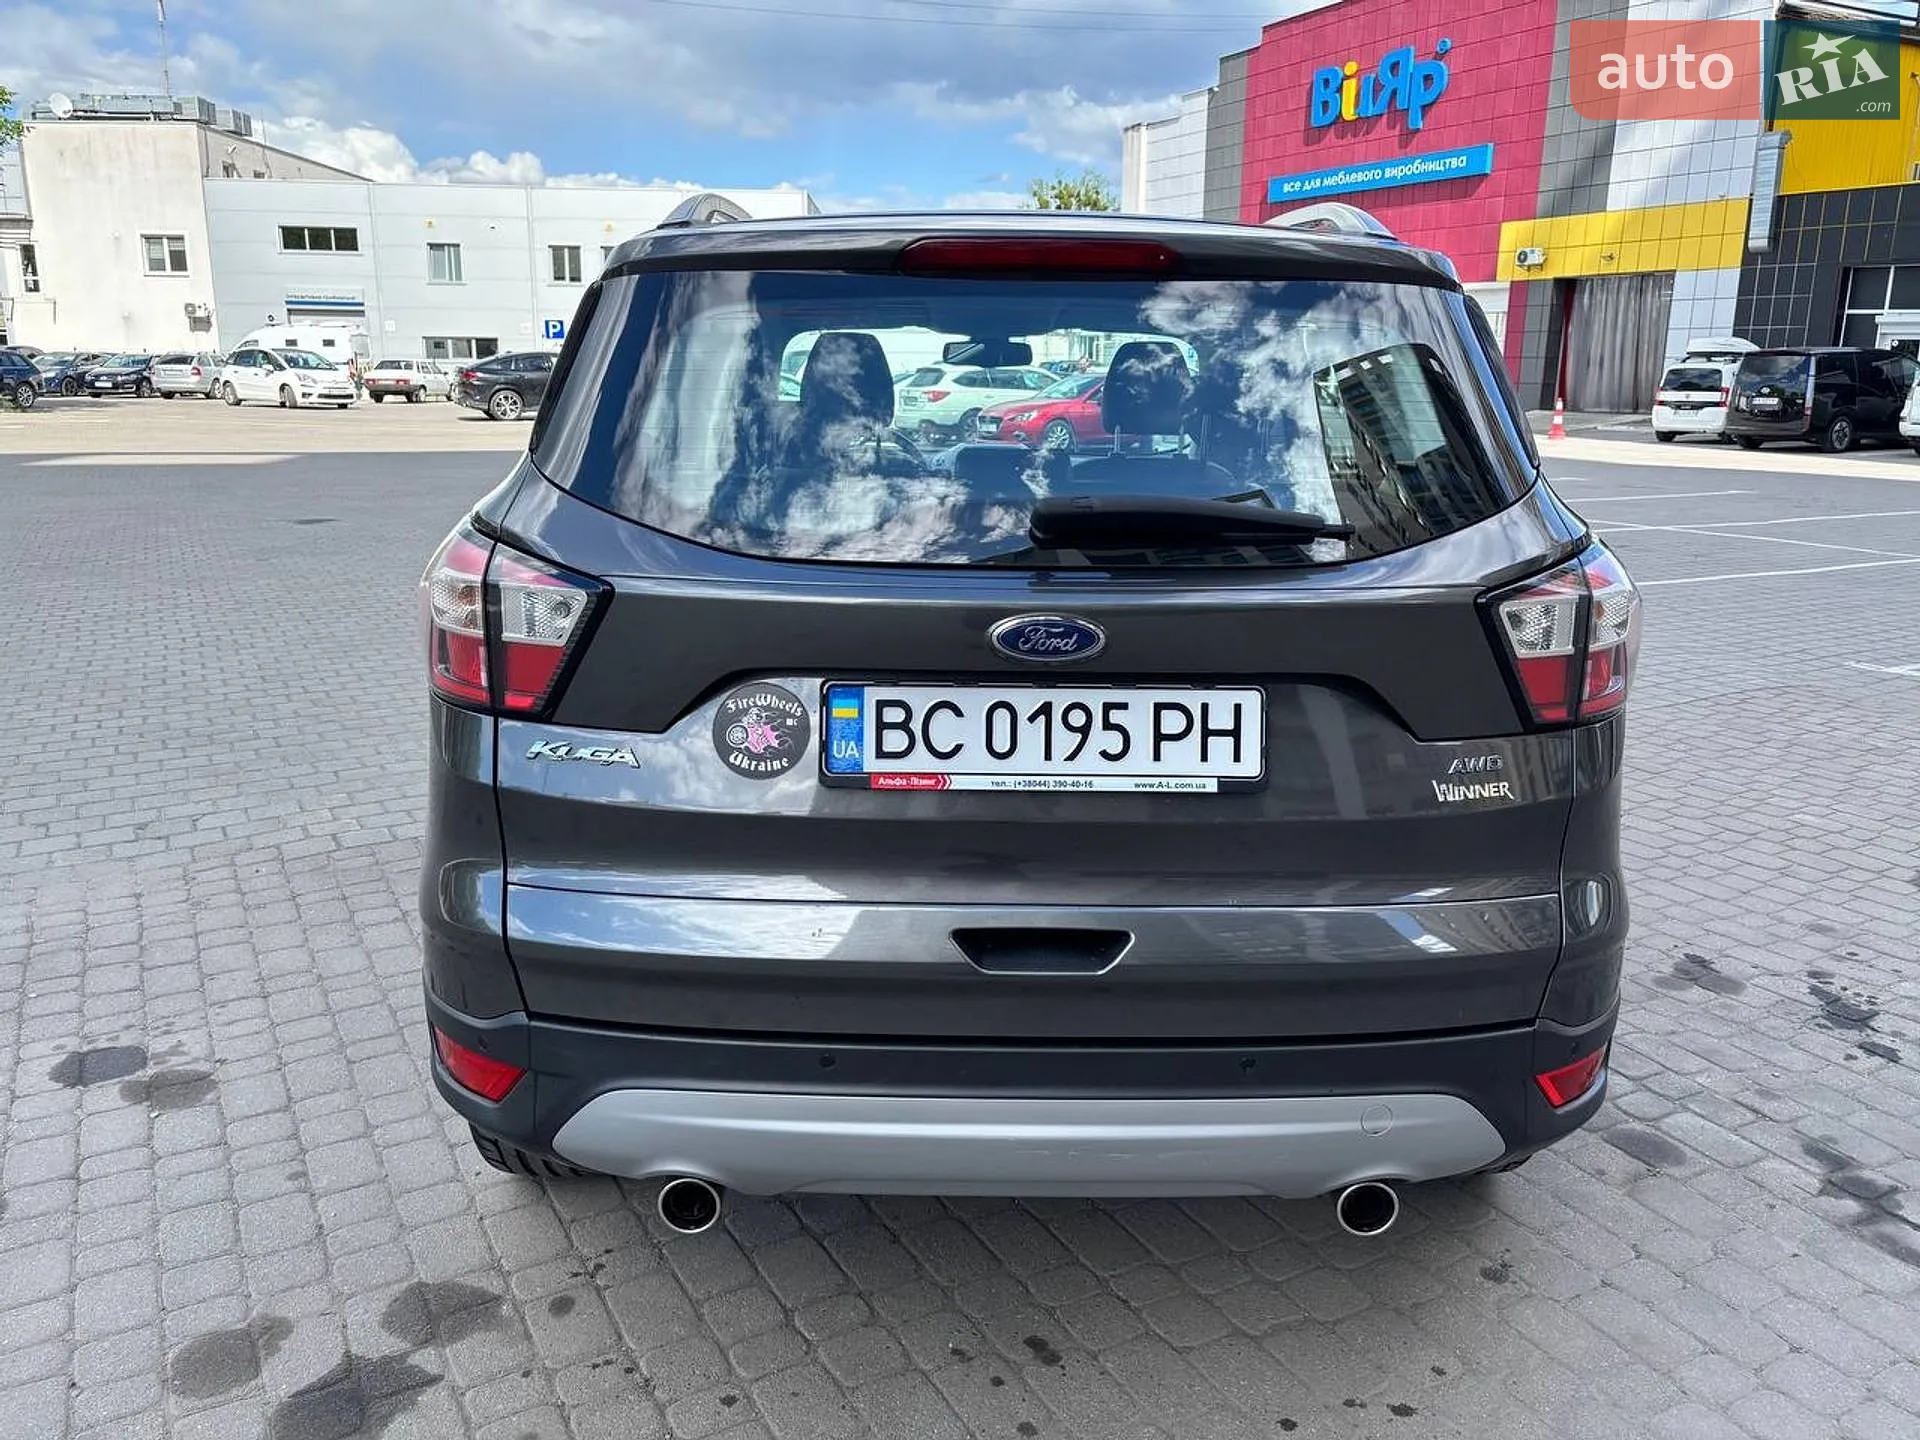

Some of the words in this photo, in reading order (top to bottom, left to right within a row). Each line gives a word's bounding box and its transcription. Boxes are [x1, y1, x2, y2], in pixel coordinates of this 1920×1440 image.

[1283, 181, 1301, 193] все
[1302, 178, 1322, 192] для
[1322, 169, 1383, 188] меблевого
[1384, 154, 1468, 180] виробництва
[548, 320, 562, 338] P
[1018, 625, 1080, 651] Ford
[725, 693, 804, 718] FireWheels
[874, 699, 965, 761] BC
[985, 700, 1131, 763] 0195
[1152, 701, 1242, 763] PH
[832, 739, 860, 759] UA
[728, 751, 790, 772] Ukraine
[1448, 755, 1504, 774] AWD
[1431, 779, 1515, 802] WINNER
